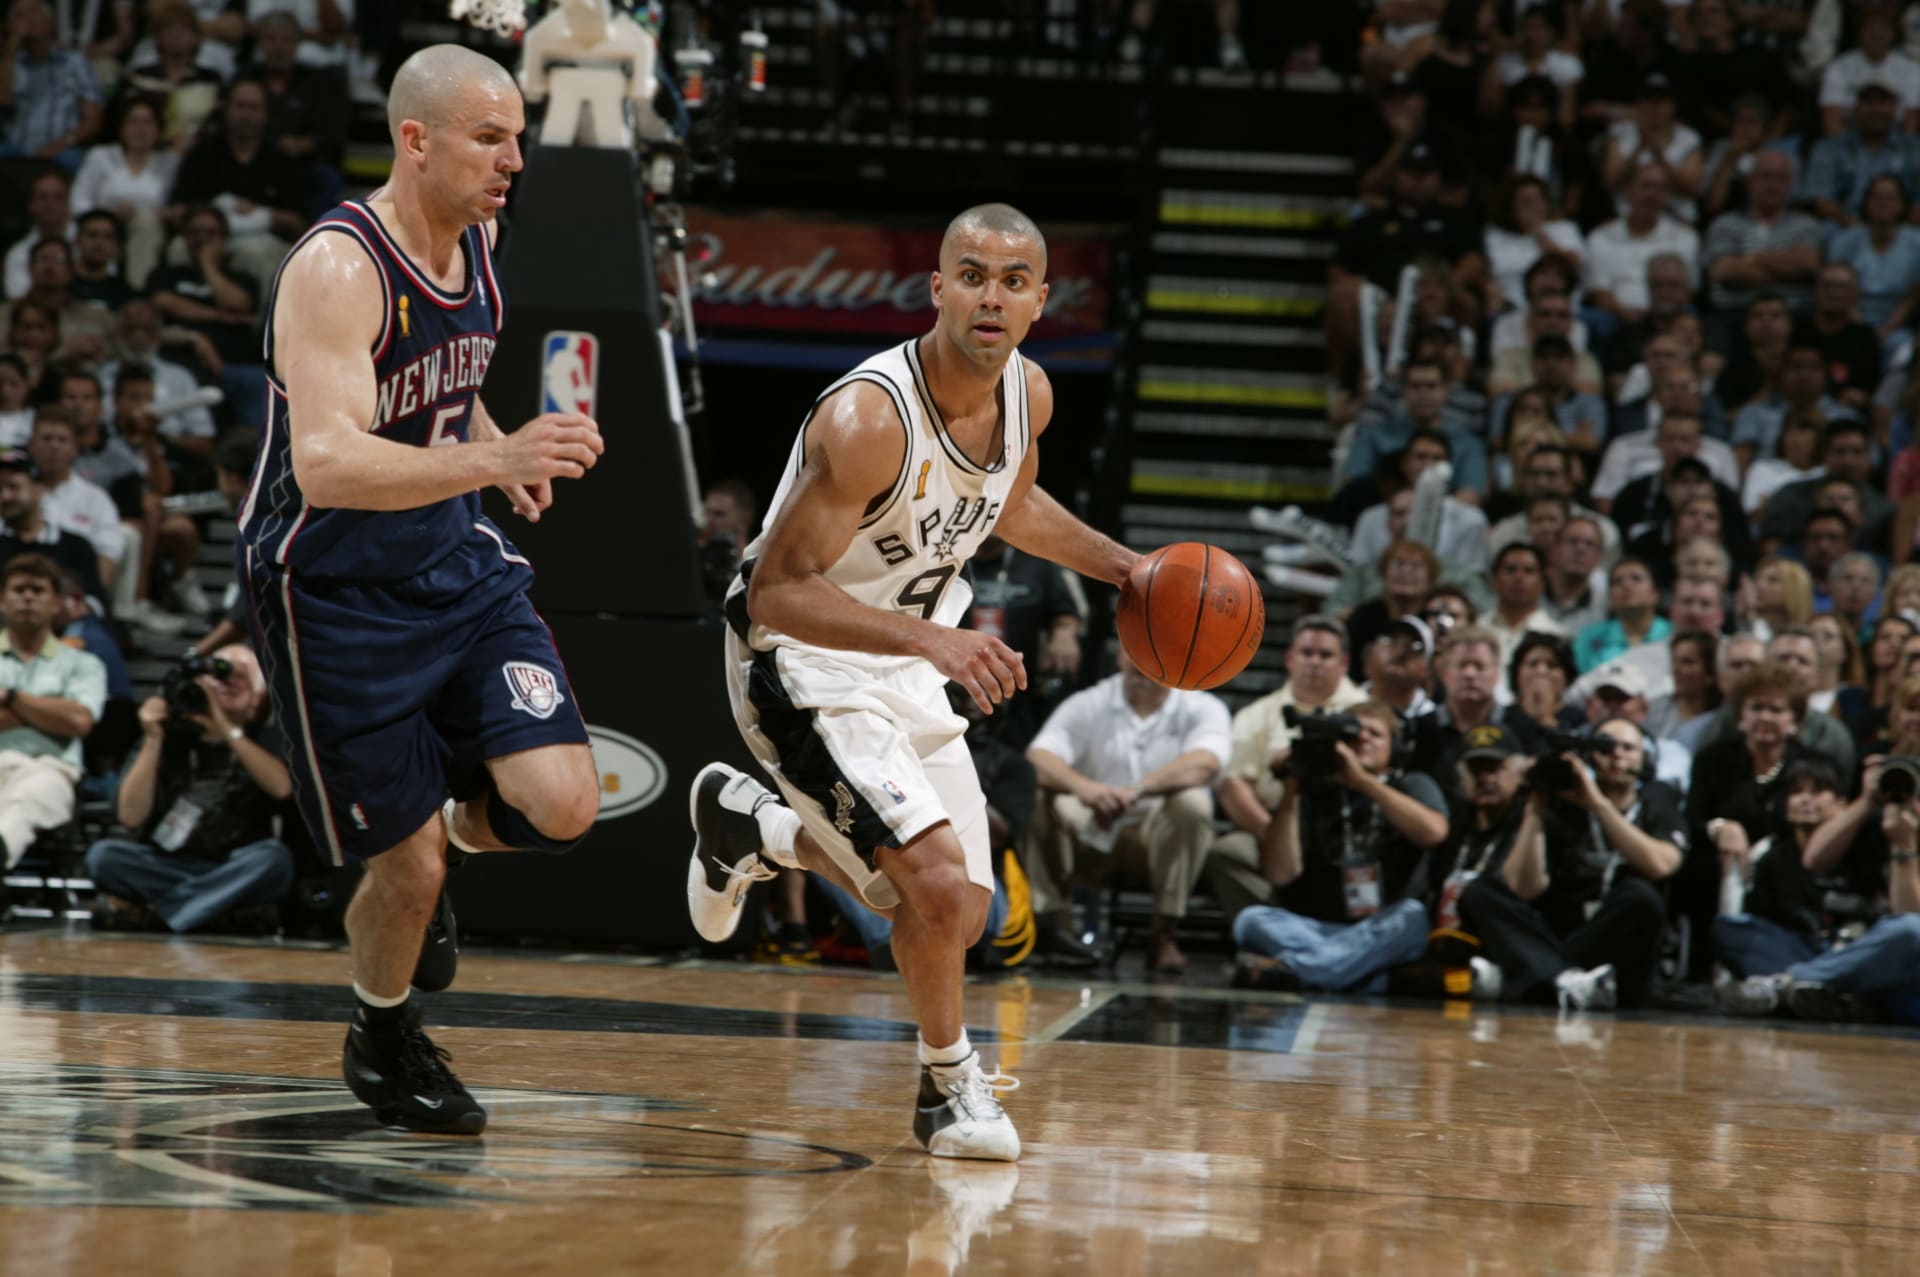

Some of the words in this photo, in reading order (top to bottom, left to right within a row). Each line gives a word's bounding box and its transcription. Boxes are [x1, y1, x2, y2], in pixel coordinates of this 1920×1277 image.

[370, 347, 442, 433] NEW
[443, 335, 496, 394] JERS
[427, 402, 466, 447] 5
[894, 560, 958, 620] 9
[511, 667, 554, 697] NETS
